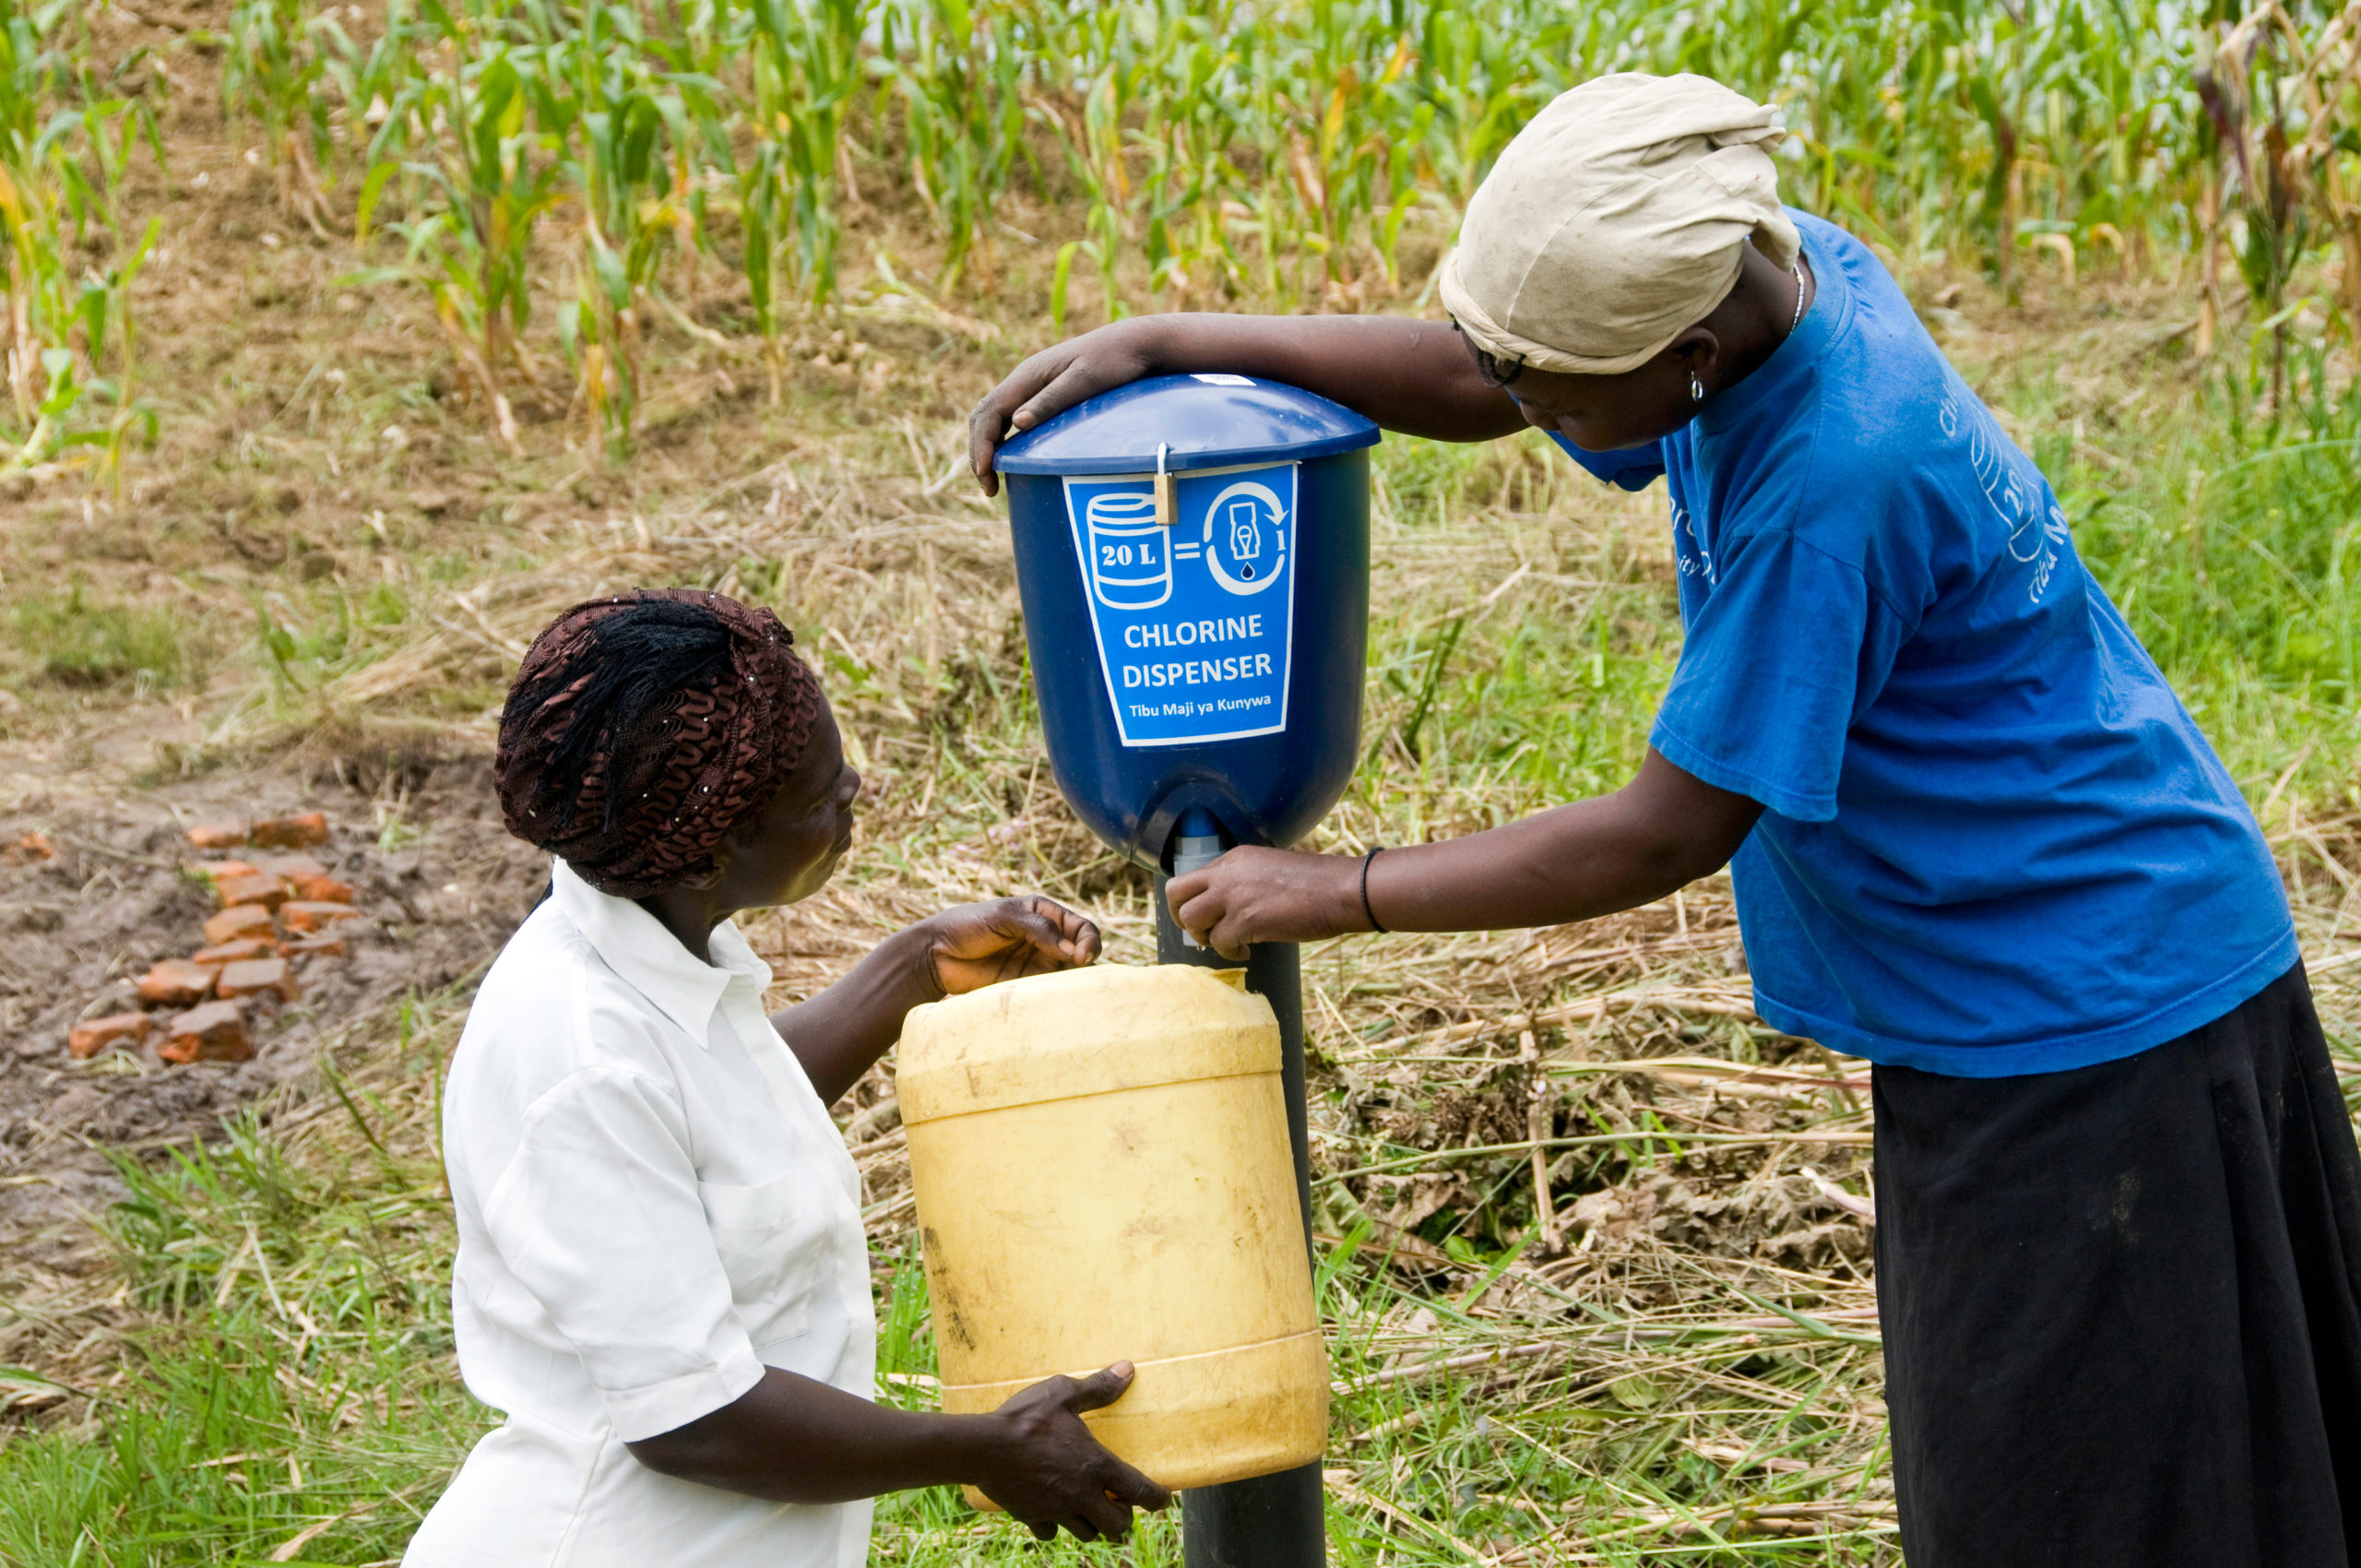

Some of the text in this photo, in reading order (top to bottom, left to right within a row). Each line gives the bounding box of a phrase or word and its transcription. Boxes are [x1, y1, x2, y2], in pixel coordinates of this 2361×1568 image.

[2004, 469, 2023, 519] 20
[1101, 544, 1133, 566] 20
[1138, 543, 1157, 565] L
[1679, 554, 1701, 576] ity
[1124, 613, 1264, 648] CHLORINE
[1122, 653, 1273, 688] DISPENSER
[1129, 695, 1272, 718] Tibu Maji ya Kunywa
